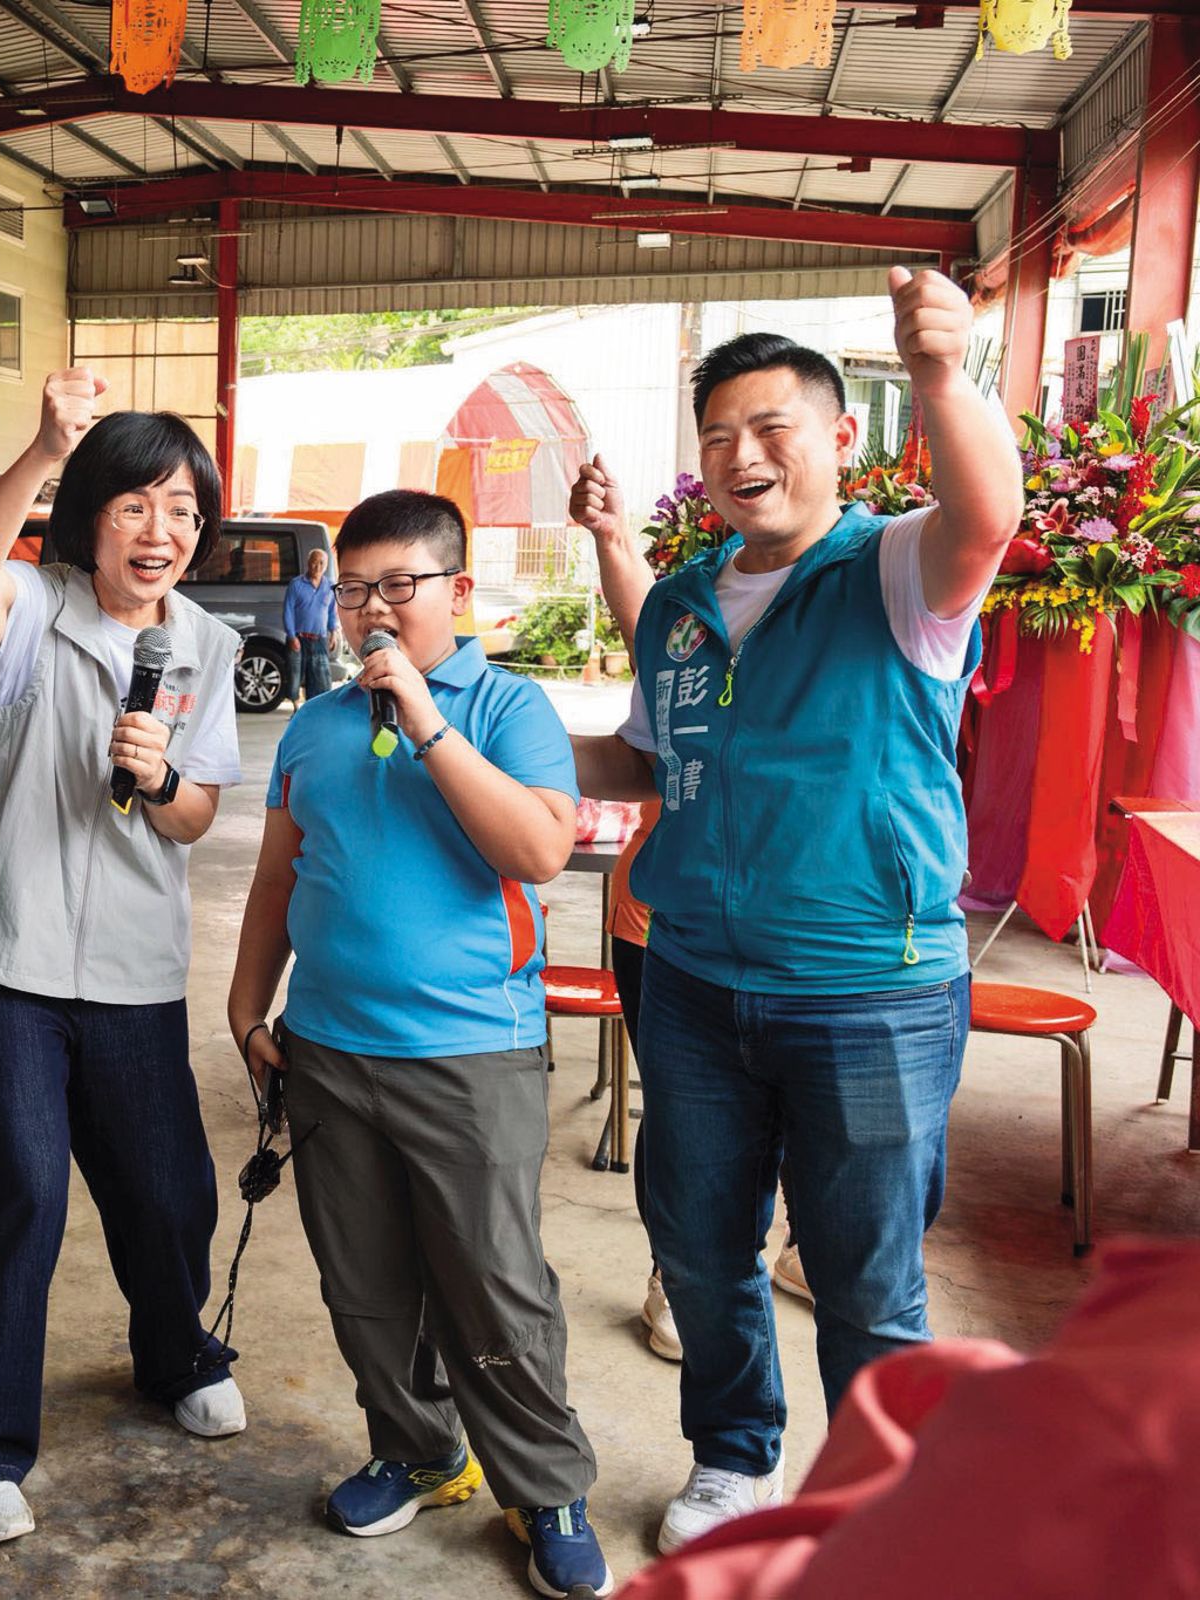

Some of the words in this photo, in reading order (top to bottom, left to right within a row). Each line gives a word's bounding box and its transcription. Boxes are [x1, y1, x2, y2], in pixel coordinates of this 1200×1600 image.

[1075, 344, 1087, 417] 圓滿成功
[656, 676, 681, 800] 新北市議員
[673, 664, 711, 801] 彭一書
